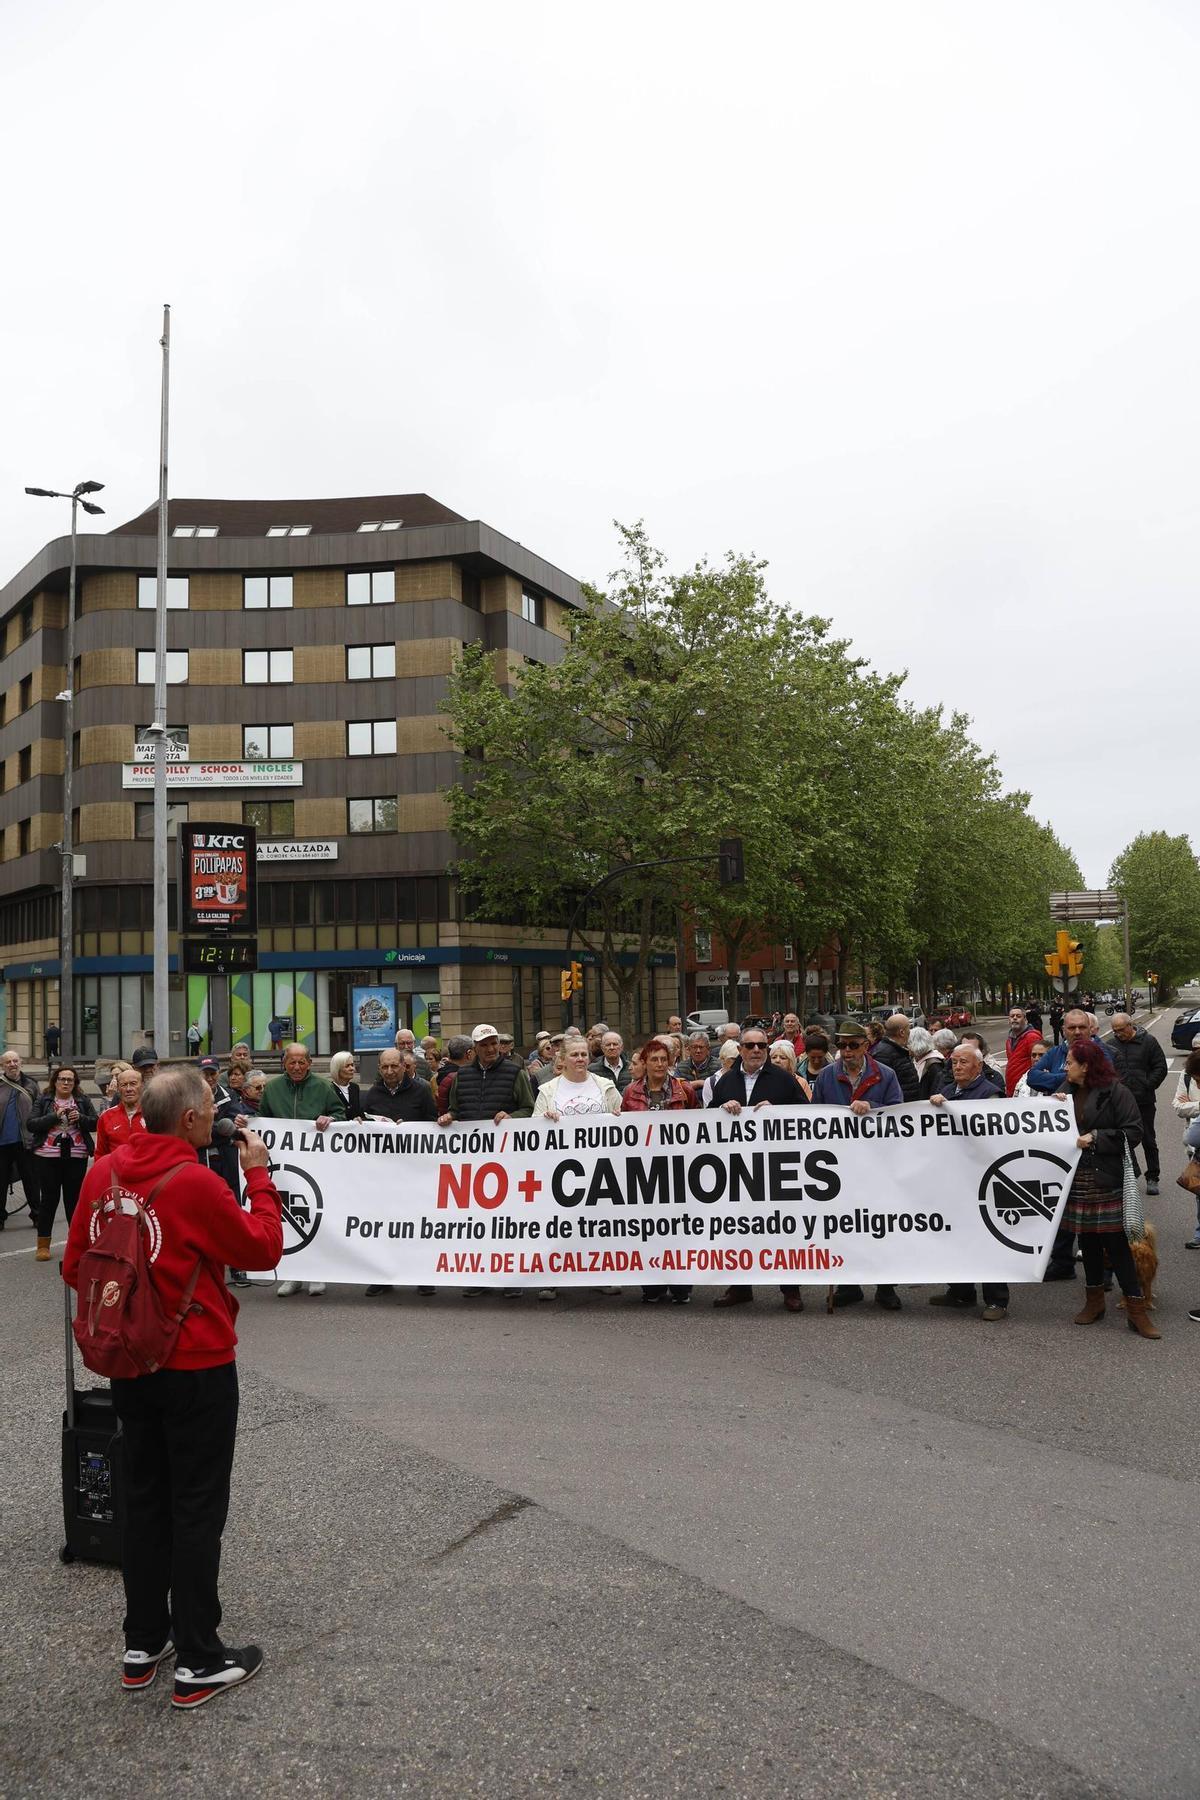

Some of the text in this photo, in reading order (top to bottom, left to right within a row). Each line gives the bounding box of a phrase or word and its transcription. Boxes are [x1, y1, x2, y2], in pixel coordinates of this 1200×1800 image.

[133, 764, 293, 774] PICCILLY SCHOOL INGLES
[207, 834, 245, 849] KFC
[283, 845, 330, 853] CALZADA
[200, 947, 247, 962] 12:11
[398, 953, 426, 962] Unicaja
[250, 1130, 276, 1150] O
[280, 1131, 294, 1151] A
[300, 1132, 325, 1153] LA
[330, 1128, 495, 1154] CONTAMINACIÓN
[513, 1130, 540, 1152] NO
[545, 1128, 570, 1151] AL
[574, 1125, 639, 1149] RUIDO
[660, 1123, 690, 1145] NO
[696, 1122, 711, 1144] A
[716, 1120, 757, 1144] LAS
[763, 1110, 915, 1142] MERCANCÍAS
[921, 1109, 1071, 1137] PELIGROSAS
[436, 1161, 509, 1210] NO
[551, 1150, 842, 1208] CAMIONES
[345, 1208, 952, 1243] Por un barrio libre de transporte pesado y peligroso.
[436, 1244, 845, 1273] A.V.V. DE LA CALZADA «ALFONSO CAMÍN»
